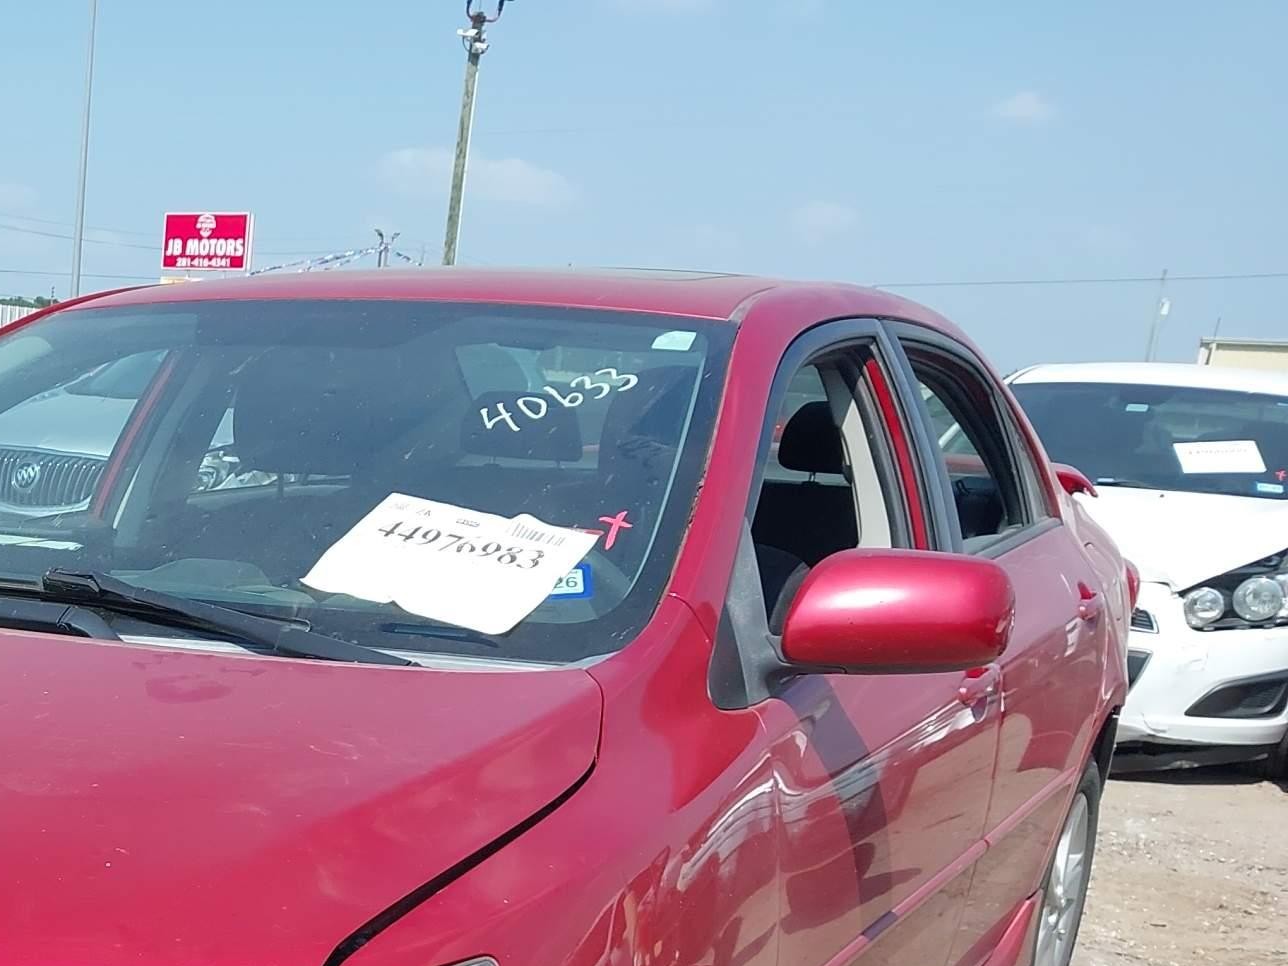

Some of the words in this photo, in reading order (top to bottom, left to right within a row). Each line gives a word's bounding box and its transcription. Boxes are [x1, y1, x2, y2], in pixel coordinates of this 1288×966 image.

[166, 238, 183, 256] JB
[185, 238, 243, 256] MOTORS
[480, 368, 638, 432] 40633
[378, 521, 545, 569] 44976983
